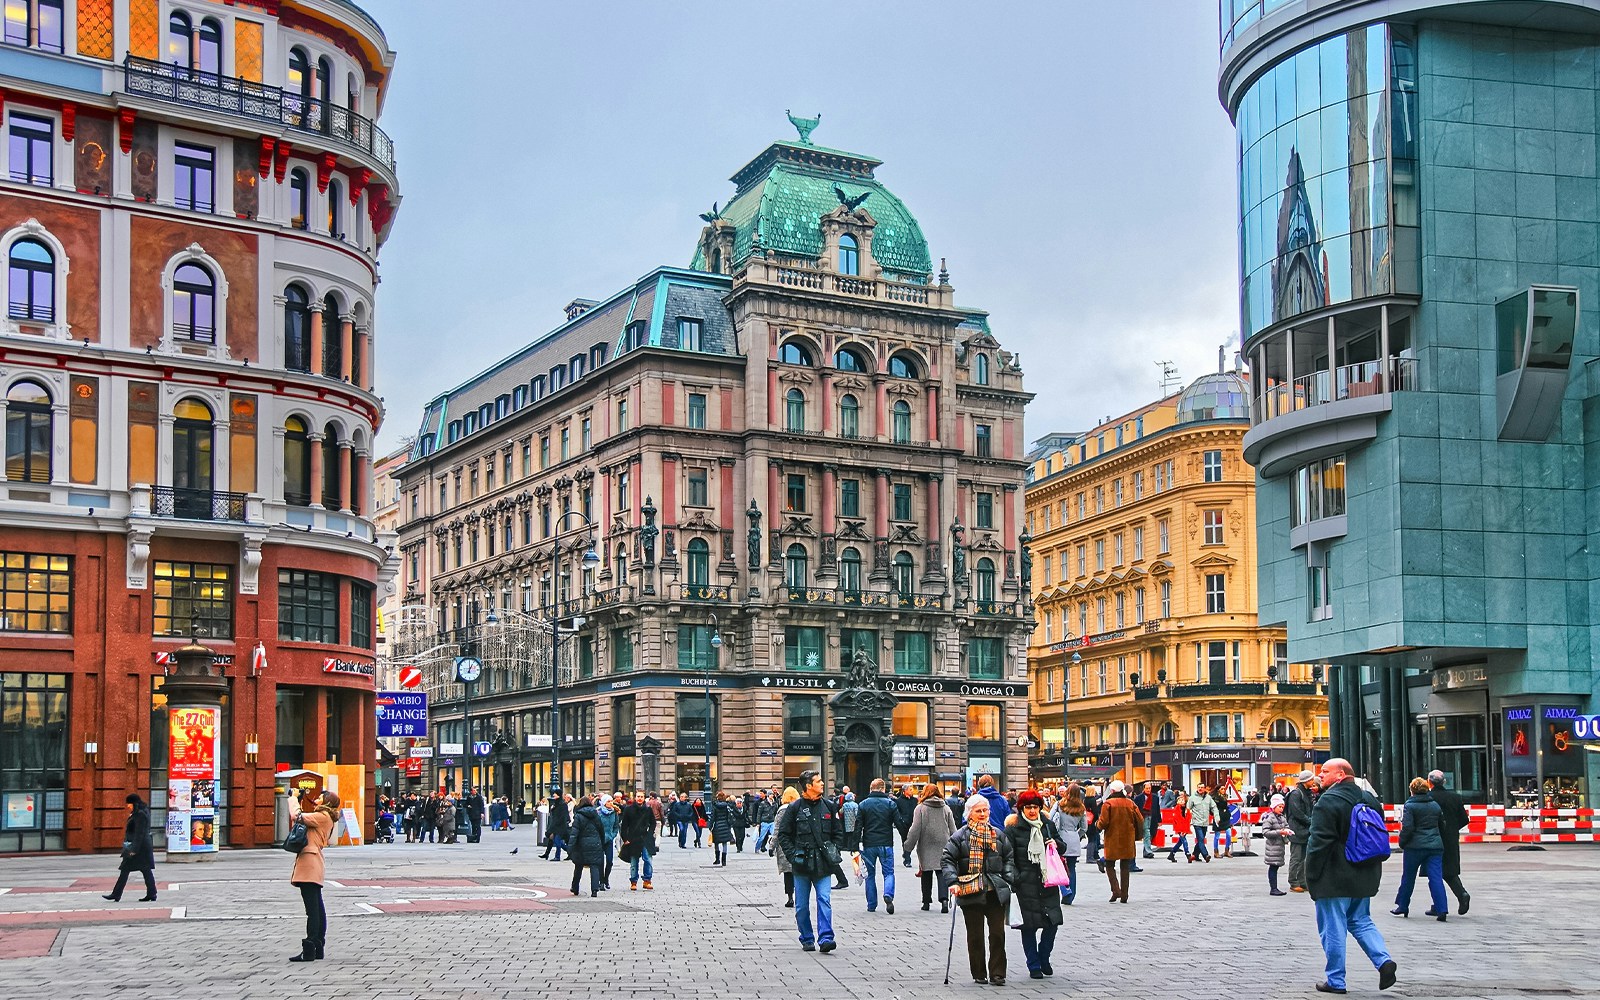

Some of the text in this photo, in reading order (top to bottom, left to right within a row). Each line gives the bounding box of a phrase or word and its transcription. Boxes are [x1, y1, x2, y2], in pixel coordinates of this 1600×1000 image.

[336, 659, 355, 672] Bank
[776, 678, 822, 687] PILSTL
[897, 683, 930, 692] OMEGA
[971, 686, 1003, 696] OMEGA
[384, 696, 422, 705] AMBIO
[173, 713, 214, 726] The 27 Club
[1575, 720, 1587, 738] U
[480, 744, 490, 755] U
[1195, 751, 1240, 761] Marionnaud
